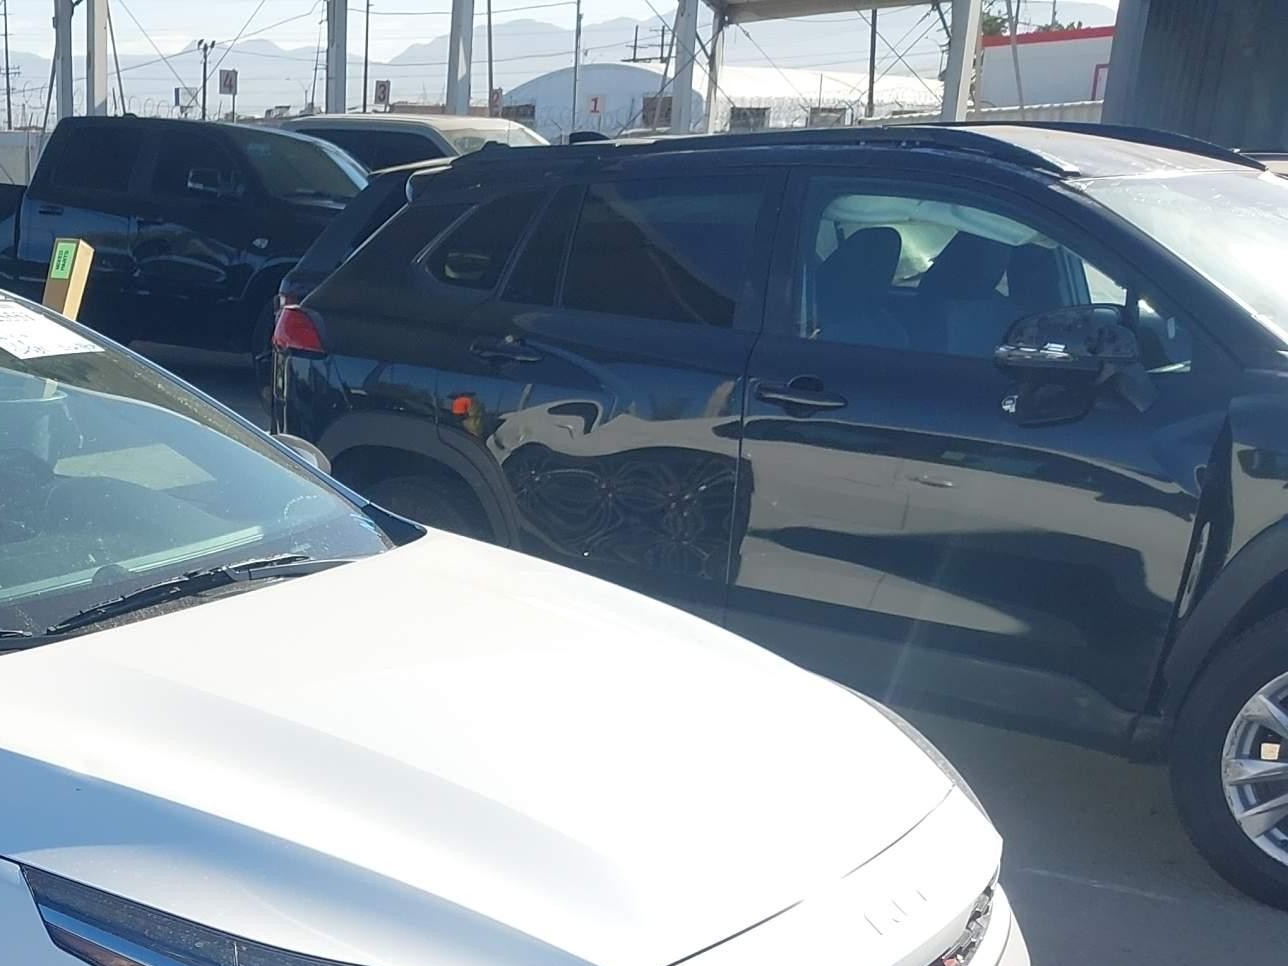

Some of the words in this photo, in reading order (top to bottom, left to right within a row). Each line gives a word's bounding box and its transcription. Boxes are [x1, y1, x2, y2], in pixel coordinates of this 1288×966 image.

[223, 75, 233, 91] 4
[378, 83, 386, 101] 3
[590, 97, 600, 113] 1
